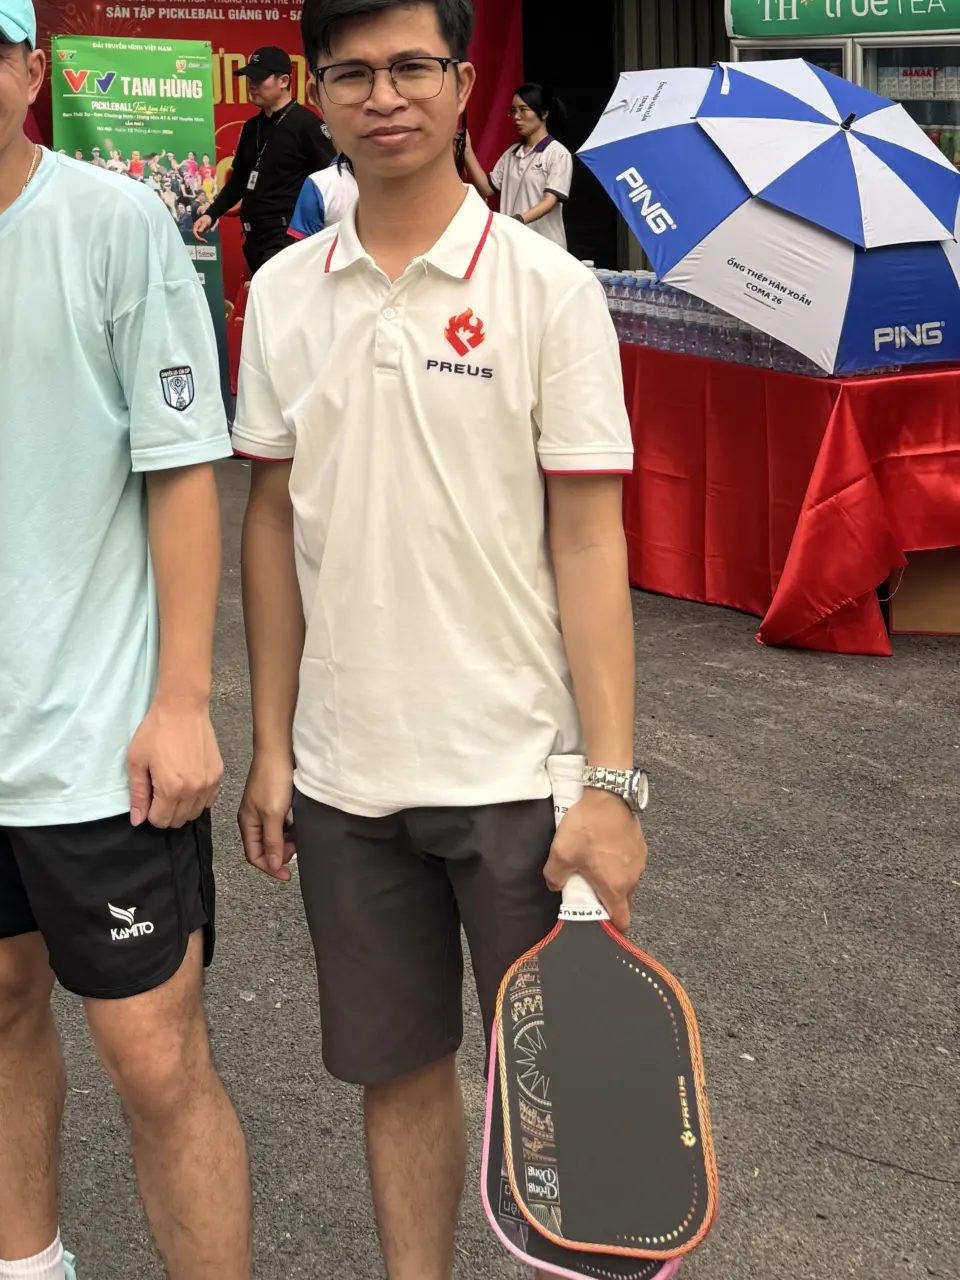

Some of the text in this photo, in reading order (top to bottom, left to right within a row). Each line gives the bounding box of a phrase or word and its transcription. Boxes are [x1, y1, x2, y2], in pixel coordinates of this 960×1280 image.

[106, 5, 130, 19] SÂN
[134, 6, 155, 21] TẬP
[158, 7, 224, 20] PICKLEBALL
[227, 6, 262, 21] GIẢNG
[265, 7, 279, 21] VÕ
[62, 69, 117, 94] VTV
[120, 76, 156, 96] TAM
[159, 74, 203, 99] HÙNG
[91, 100, 132, 112] PICKLEBALL
[616, 166, 674, 235] PING
[727, 257, 746, 272] ỐNG
[746, 268, 768, 283] THÉP
[768, 280, 787, 293] HÀN
[745, 282, 771, 299] COMA
[771, 295, 783, 305] 26
[873, 320, 943, 352] PING
[426, 359, 494, 379] PREUS
[110, 921, 155, 941] KAMITO
[677, 1075, 691, 1130] PREUS
